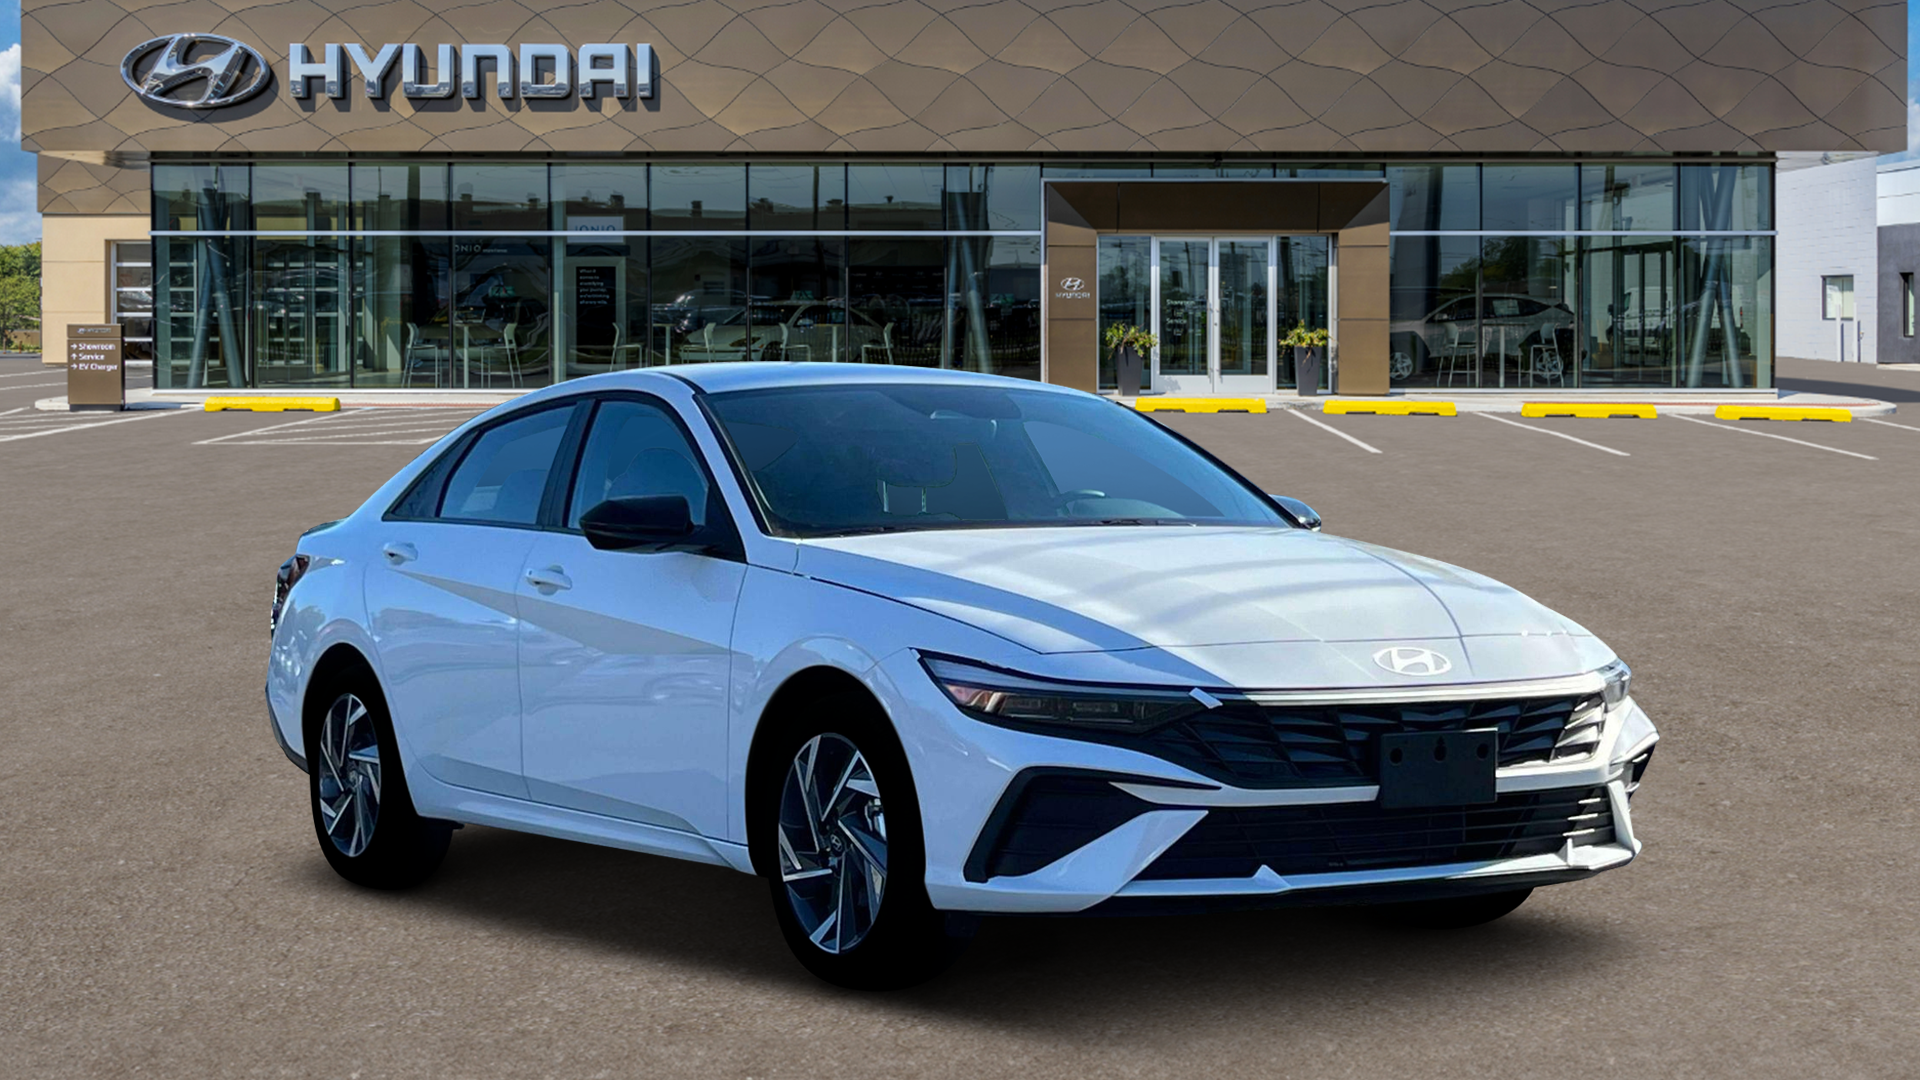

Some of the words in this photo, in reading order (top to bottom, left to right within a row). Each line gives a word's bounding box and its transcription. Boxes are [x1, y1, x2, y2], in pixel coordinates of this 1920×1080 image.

[289, 43, 653, 99] HYUNDAI
[78, 352, 105, 360] Service
[90, 363, 118, 372] Charger
